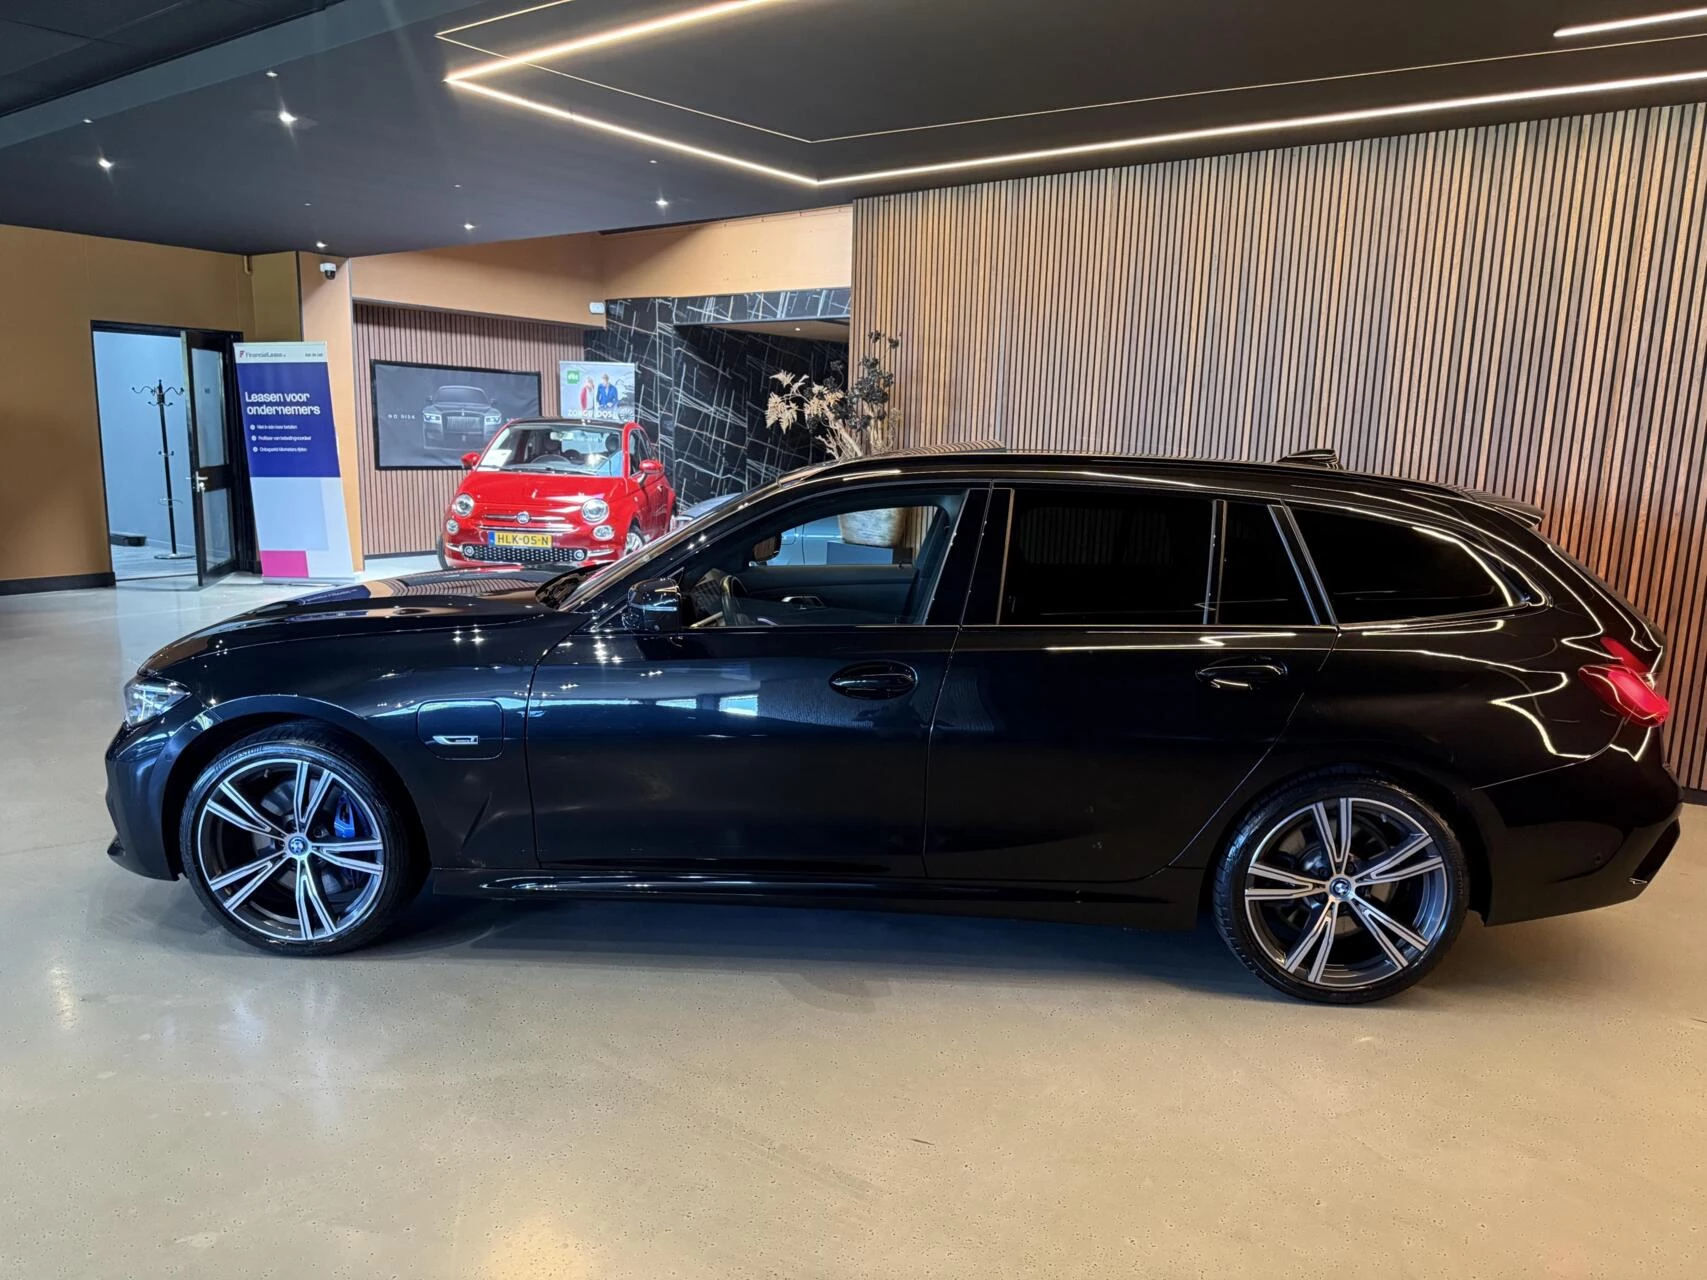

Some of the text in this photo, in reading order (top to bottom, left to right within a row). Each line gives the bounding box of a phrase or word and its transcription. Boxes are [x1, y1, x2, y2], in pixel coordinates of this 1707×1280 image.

[245, 391, 310, 402] Leasen voor
[247, 405, 320, 415] ondernemers
[497, 534, 549, 545] HLK-05-N
